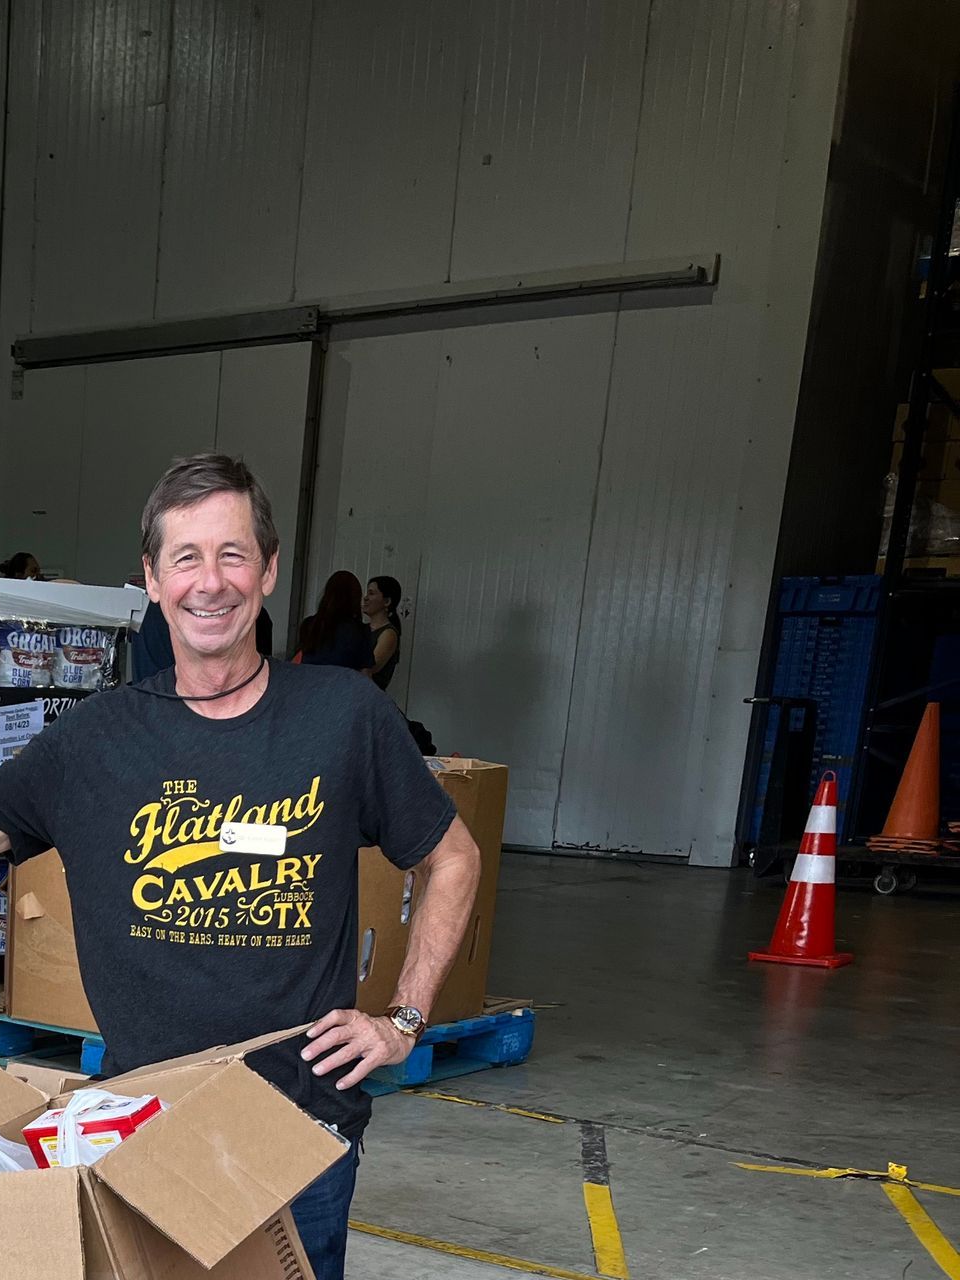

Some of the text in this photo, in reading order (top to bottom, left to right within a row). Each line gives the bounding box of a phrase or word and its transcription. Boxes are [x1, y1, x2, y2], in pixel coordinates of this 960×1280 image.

[12, 668, 32, 679] BLUE
[63, 665, 83, 676] BLUE
[11, 677, 31, 688] CORN
[62, 673, 83, 684] CORN
[5, 720, 30, 731] 08/14/23
[163, 779, 197, 796] THE
[124, 775, 324, 864] Flatland
[132, 854, 323, 911] CAVALRY
[274, 891, 315, 902] LUBBOCK
[175, 905, 230, 929] 2015
[273, 901, 312, 929] TX
[130, 925, 312, 947] EASY ON THE EARS. HEAVY ON THE HEART.
